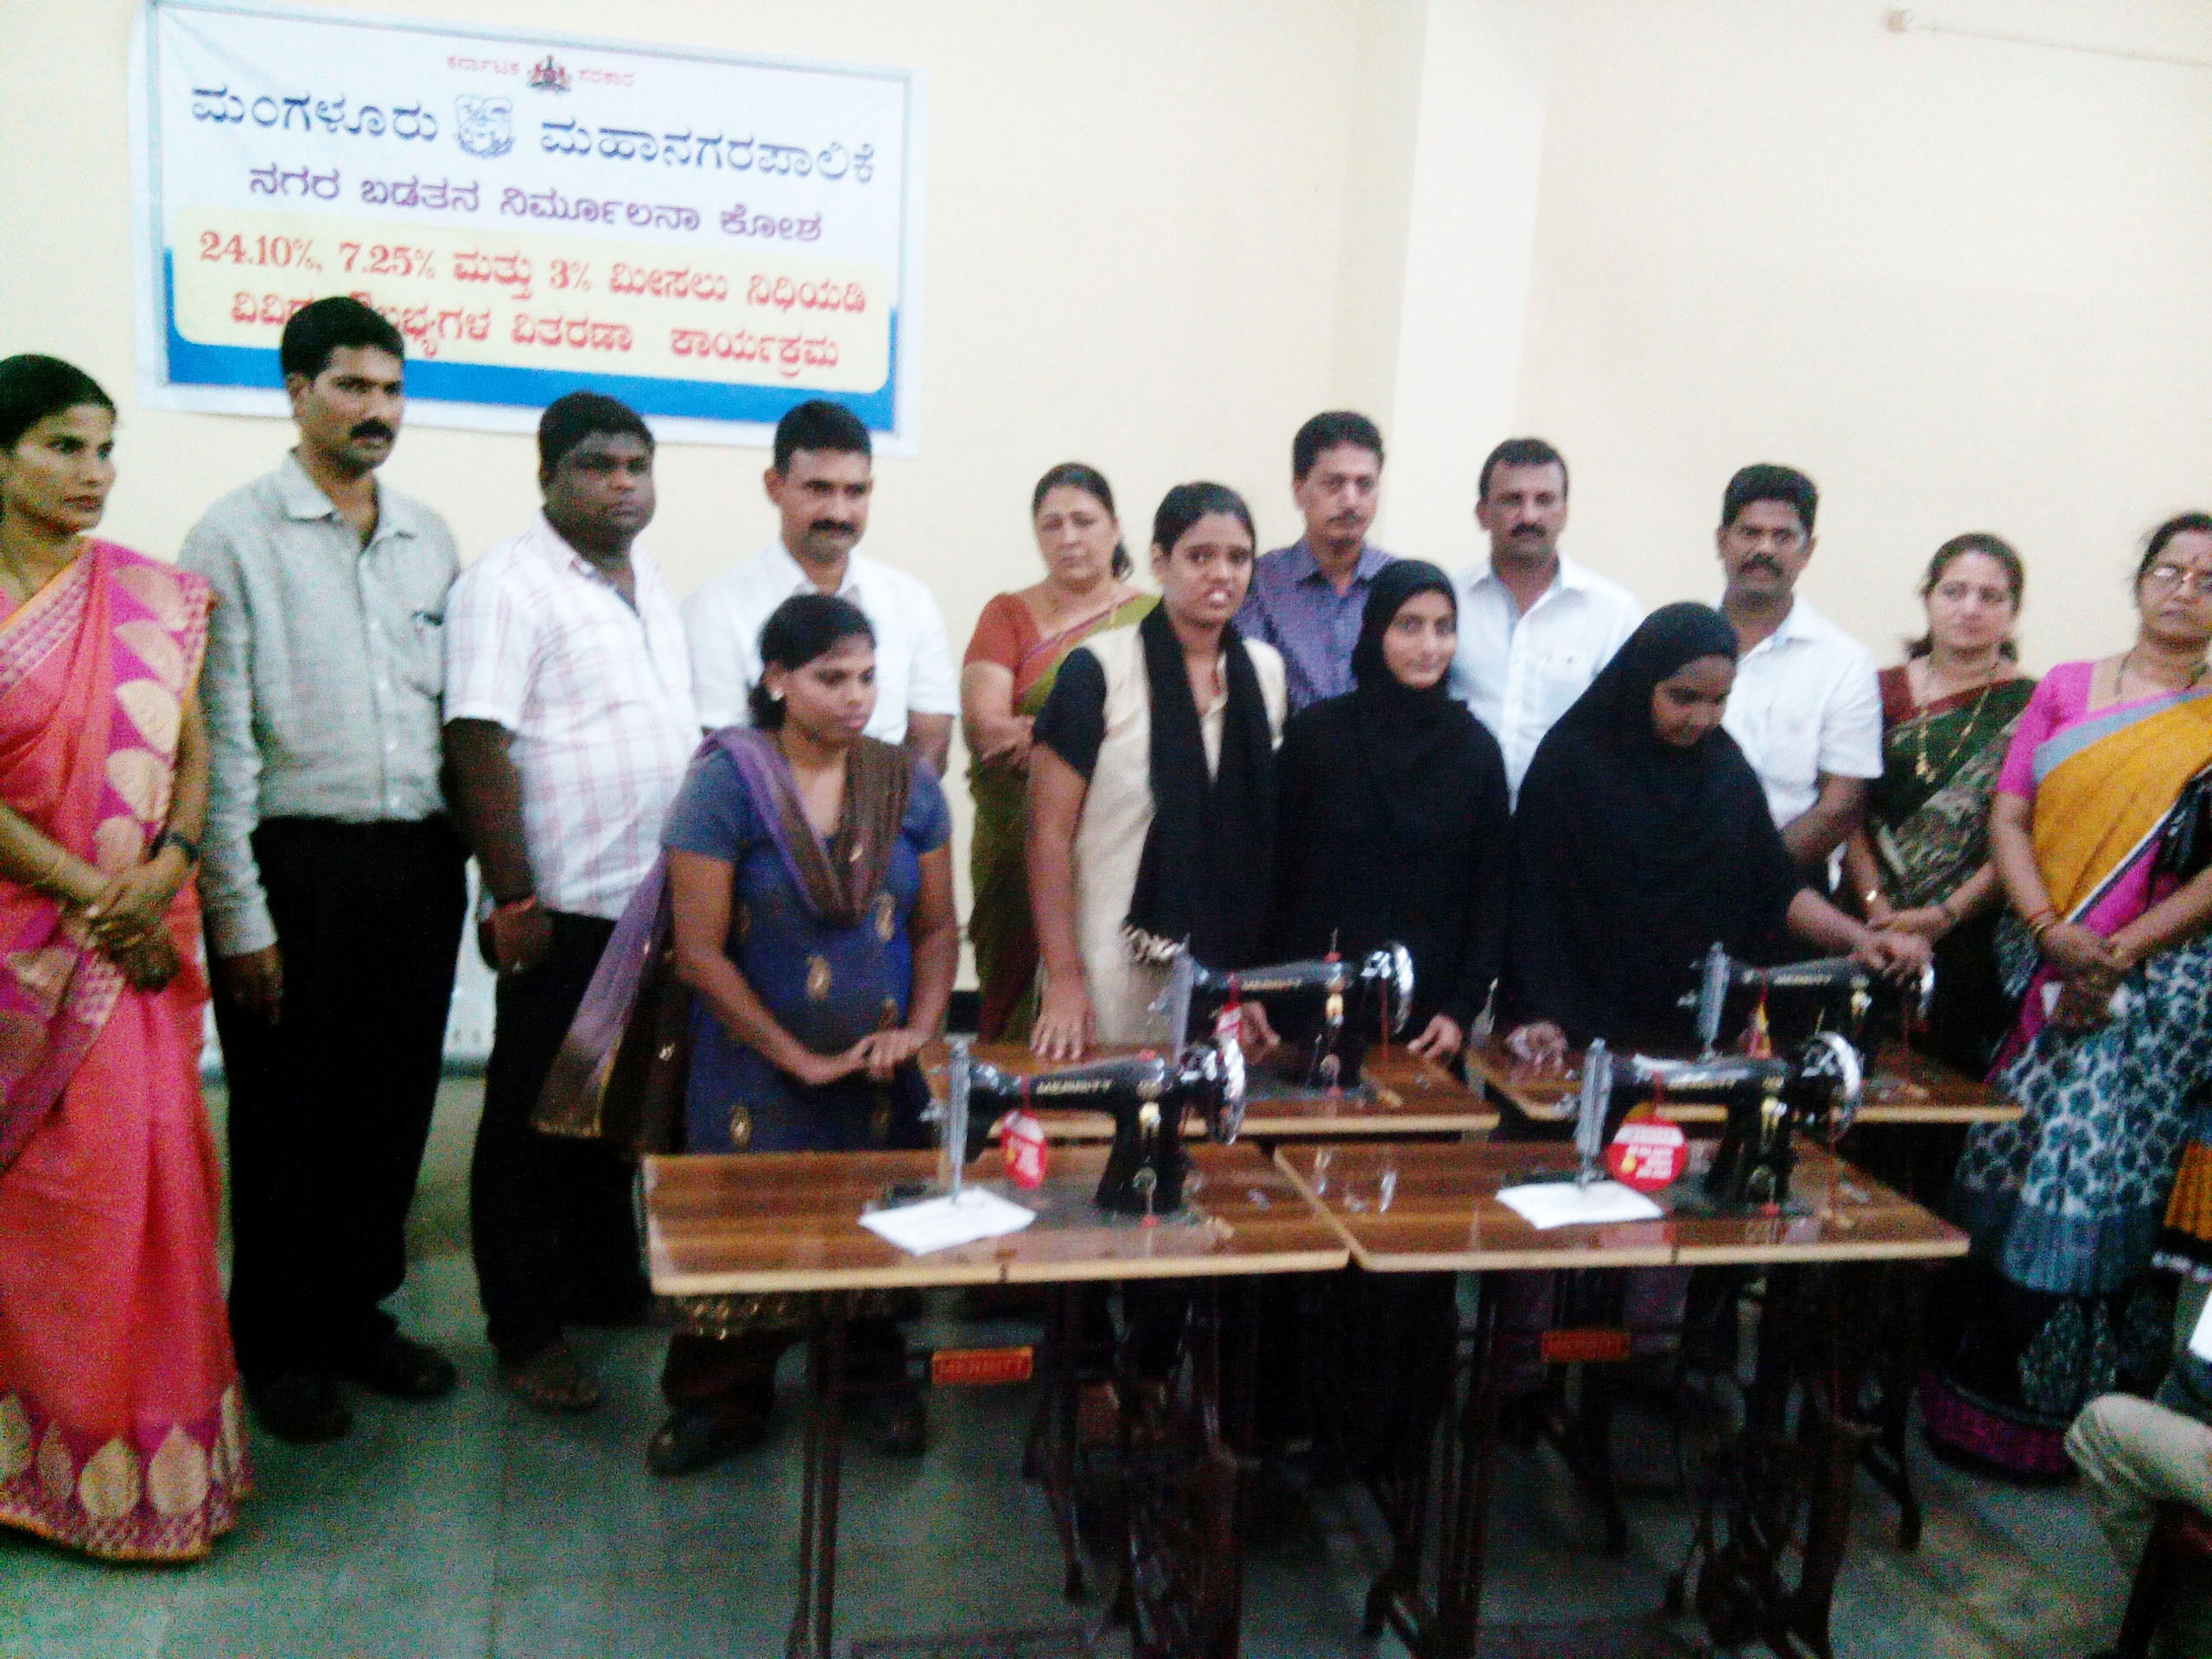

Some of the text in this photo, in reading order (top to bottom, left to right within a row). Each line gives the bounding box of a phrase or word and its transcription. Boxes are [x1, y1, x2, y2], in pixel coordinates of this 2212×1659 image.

[191, 84, 875, 184] ಮಂಗಳೂರು ಮಹಾನಗರಪಾಲಿಕೆ
[249, 162, 822, 241] ನಗರ ಬಡತನ ನಿರ್ಮೂಲನಾ ಕೋಶ
[338, 241, 435, 278] 7.25%
[452, 247, 532, 301] ಮತ್ತು
[549, 258, 591, 291] 3%
[609, 262, 728, 301] ಮೀಸಲು
[747, 272, 867, 315] ನಿಧಿಯಡಿ
[510, 312, 633, 353] ವಿತರಣಾ
[669, 327, 840, 378] ಕಾರ್ಯಕ್ರಮ
